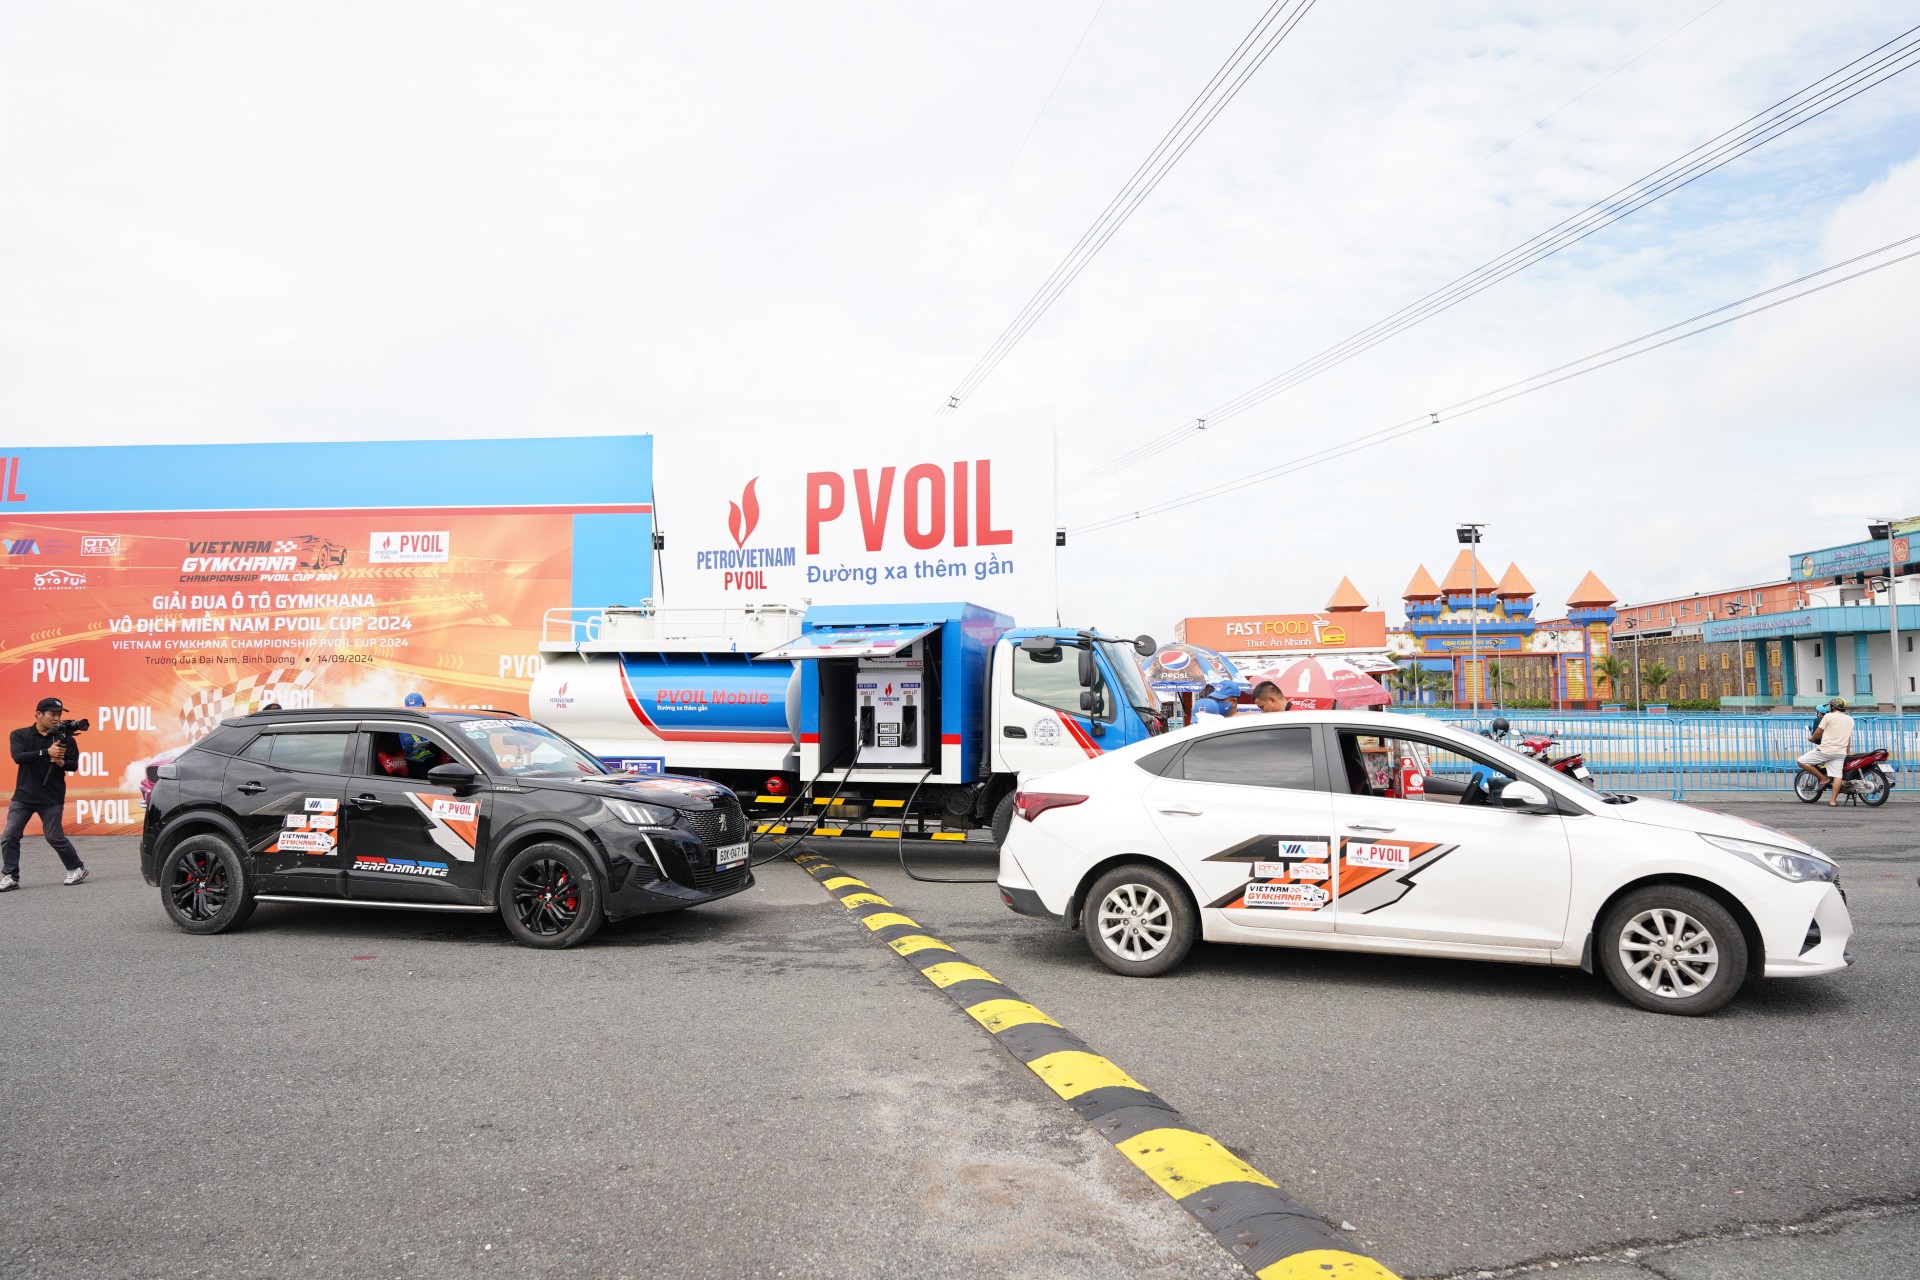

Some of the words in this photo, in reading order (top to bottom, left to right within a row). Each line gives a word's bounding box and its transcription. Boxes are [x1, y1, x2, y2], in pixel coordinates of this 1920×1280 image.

[806, 459, 1013, 555] PVOIL
[189, 541, 272, 554] VIETNAM
[400, 534, 443, 552] PVOIL
[182, 556, 298, 572] GYMKHANA
[697, 547, 795, 570] PETROVIETNAM
[806, 564, 878, 585] Đường
[884, 565, 908, 580] xa
[914, 559, 967, 578] thêm
[974, 552, 1014, 580] gần
[179, 574, 258, 583] CHAMPIONSHIP
[260, 574, 290, 582] PVOIL
[315, 573, 339, 581] 2024
[724, 571, 767, 591] PVOIL
[152, 591, 186, 610] GIẢI
[191, 595, 227, 609] ĐUA
[231, 591, 244, 609] Ô
[248, 591, 271, 609] TÔ
[275, 594, 375, 608] GYMKHANA
[109, 615, 132, 633] VÔ
[136, 618, 176, 636] ĐỊCH
[181, 611, 225, 632] MIỀN
[230, 616, 269, 632] NAM
[274, 616, 325, 631] PVOIL
[329, 616, 363, 631] CUP
[367, 616, 412, 630] 2024
[1226, 622, 1262, 636] FAST
[1264, 621, 1309, 635] FOOD
[112, 640, 161, 650] VIETNAM
[165, 639, 228, 649] GYMKHANA
[231, 639, 317, 648] CHAMPIONSHIP
[320, 638, 351, 648] PVOIL
[355, 638, 377, 647] CUP
[380, 638, 409, 647] 2024
[575, 642, 581, 652] 2
[731, 642, 737, 653] 4
[1245, 639, 1267, 648] Thức
[1270, 638, 1282, 647] Ăn
[1284, 638, 1311, 647] Nhanh
[145, 656, 177, 666] Trường
[179, 656, 196, 664] đua
[216, 656, 240, 664] Nam,
[265, 655, 296, 665] Dương
[318, 655, 373, 664] 14/09/2024
[498, 654, 546, 679] PVO
[32, 657, 90, 683] PVOIL
[1161, 672, 1188, 680] pepsi
[656, 689, 709, 704] PVOIL
[711, 689, 769, 705] Mobile
[98, 706, 157, 731] PVOIL
[65, 752, 109, 777] OIL
[76, 799, 135, 824] PVOIL
[448, 803, 472, 816] PVOIL
[1370, 846, 1405, 863] PVOIL
[352, 861, 450, 877] PERFORMANCE
[1247, 893, 1302, 901] GYMKHANA
[1249, 885, 1289, 893] VIETNAM
